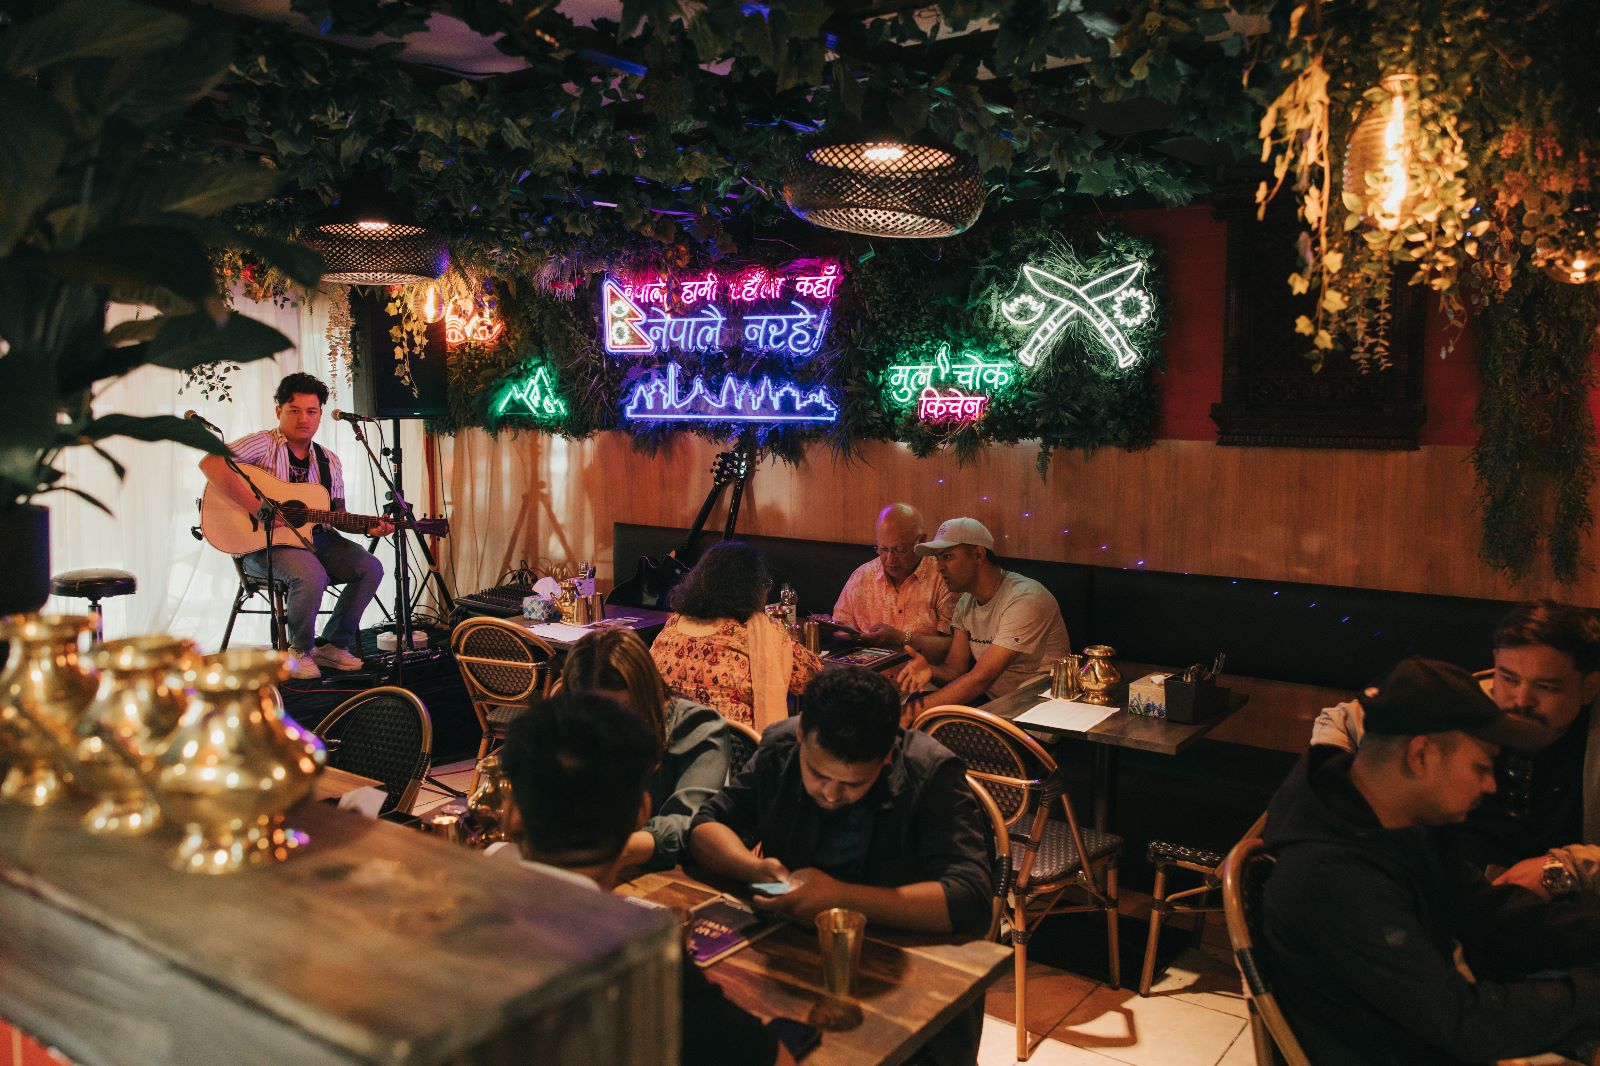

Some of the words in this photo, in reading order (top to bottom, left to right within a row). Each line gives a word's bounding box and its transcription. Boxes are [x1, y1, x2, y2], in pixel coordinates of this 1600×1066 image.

[681, 272, 718, 304] हामी
[795, 265, 837, 299] कहाँ
[647, 304, 726, 350] नेपालै
[889, 365, 937, 402] मुल
[951, 353, 1014, 390] चोक
[919, 387, 986, 418] किचेन
